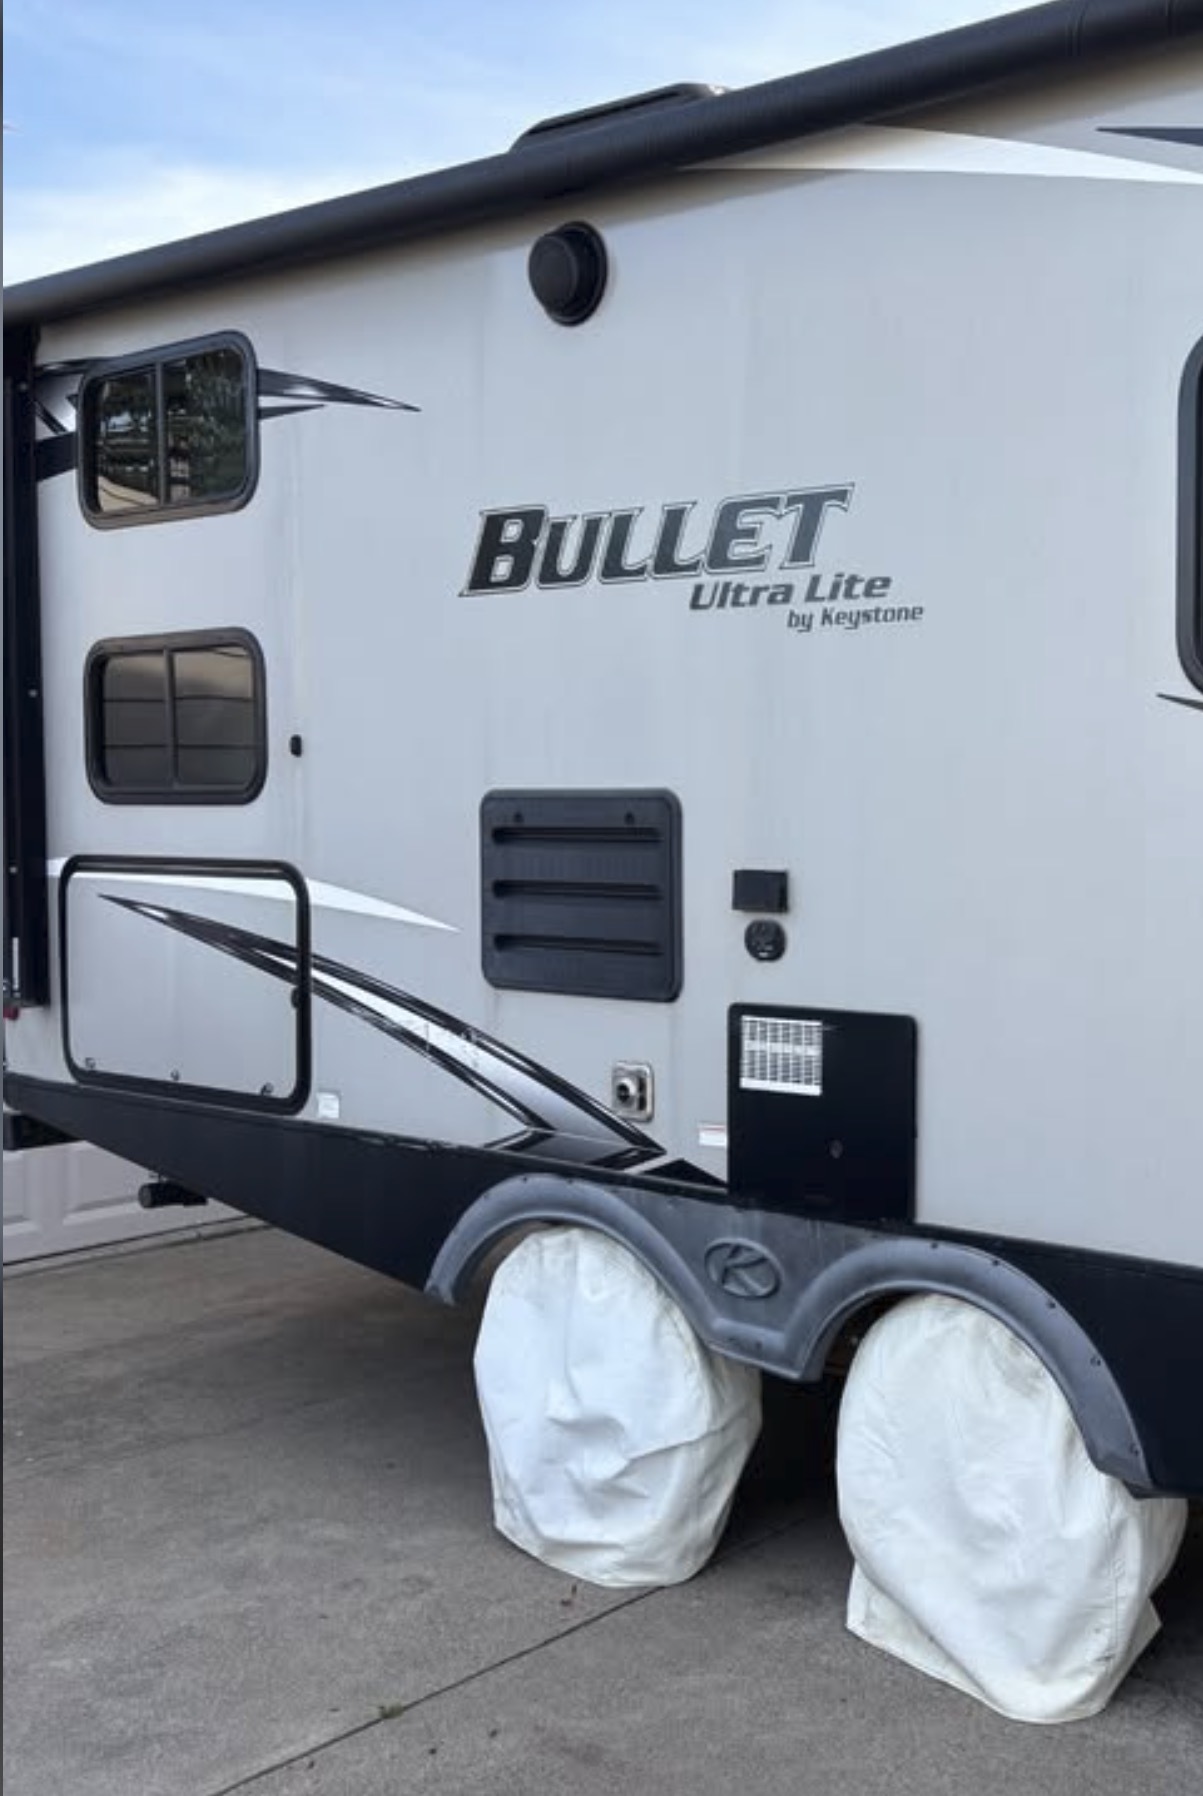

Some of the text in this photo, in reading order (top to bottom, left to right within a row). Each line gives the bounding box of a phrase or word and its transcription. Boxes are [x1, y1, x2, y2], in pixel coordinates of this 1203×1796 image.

[458, 482, 855, 597] BULLET
[689, 573, 892, 610] Ultra Lite
[787, 605, 924, 632] by Keystone
